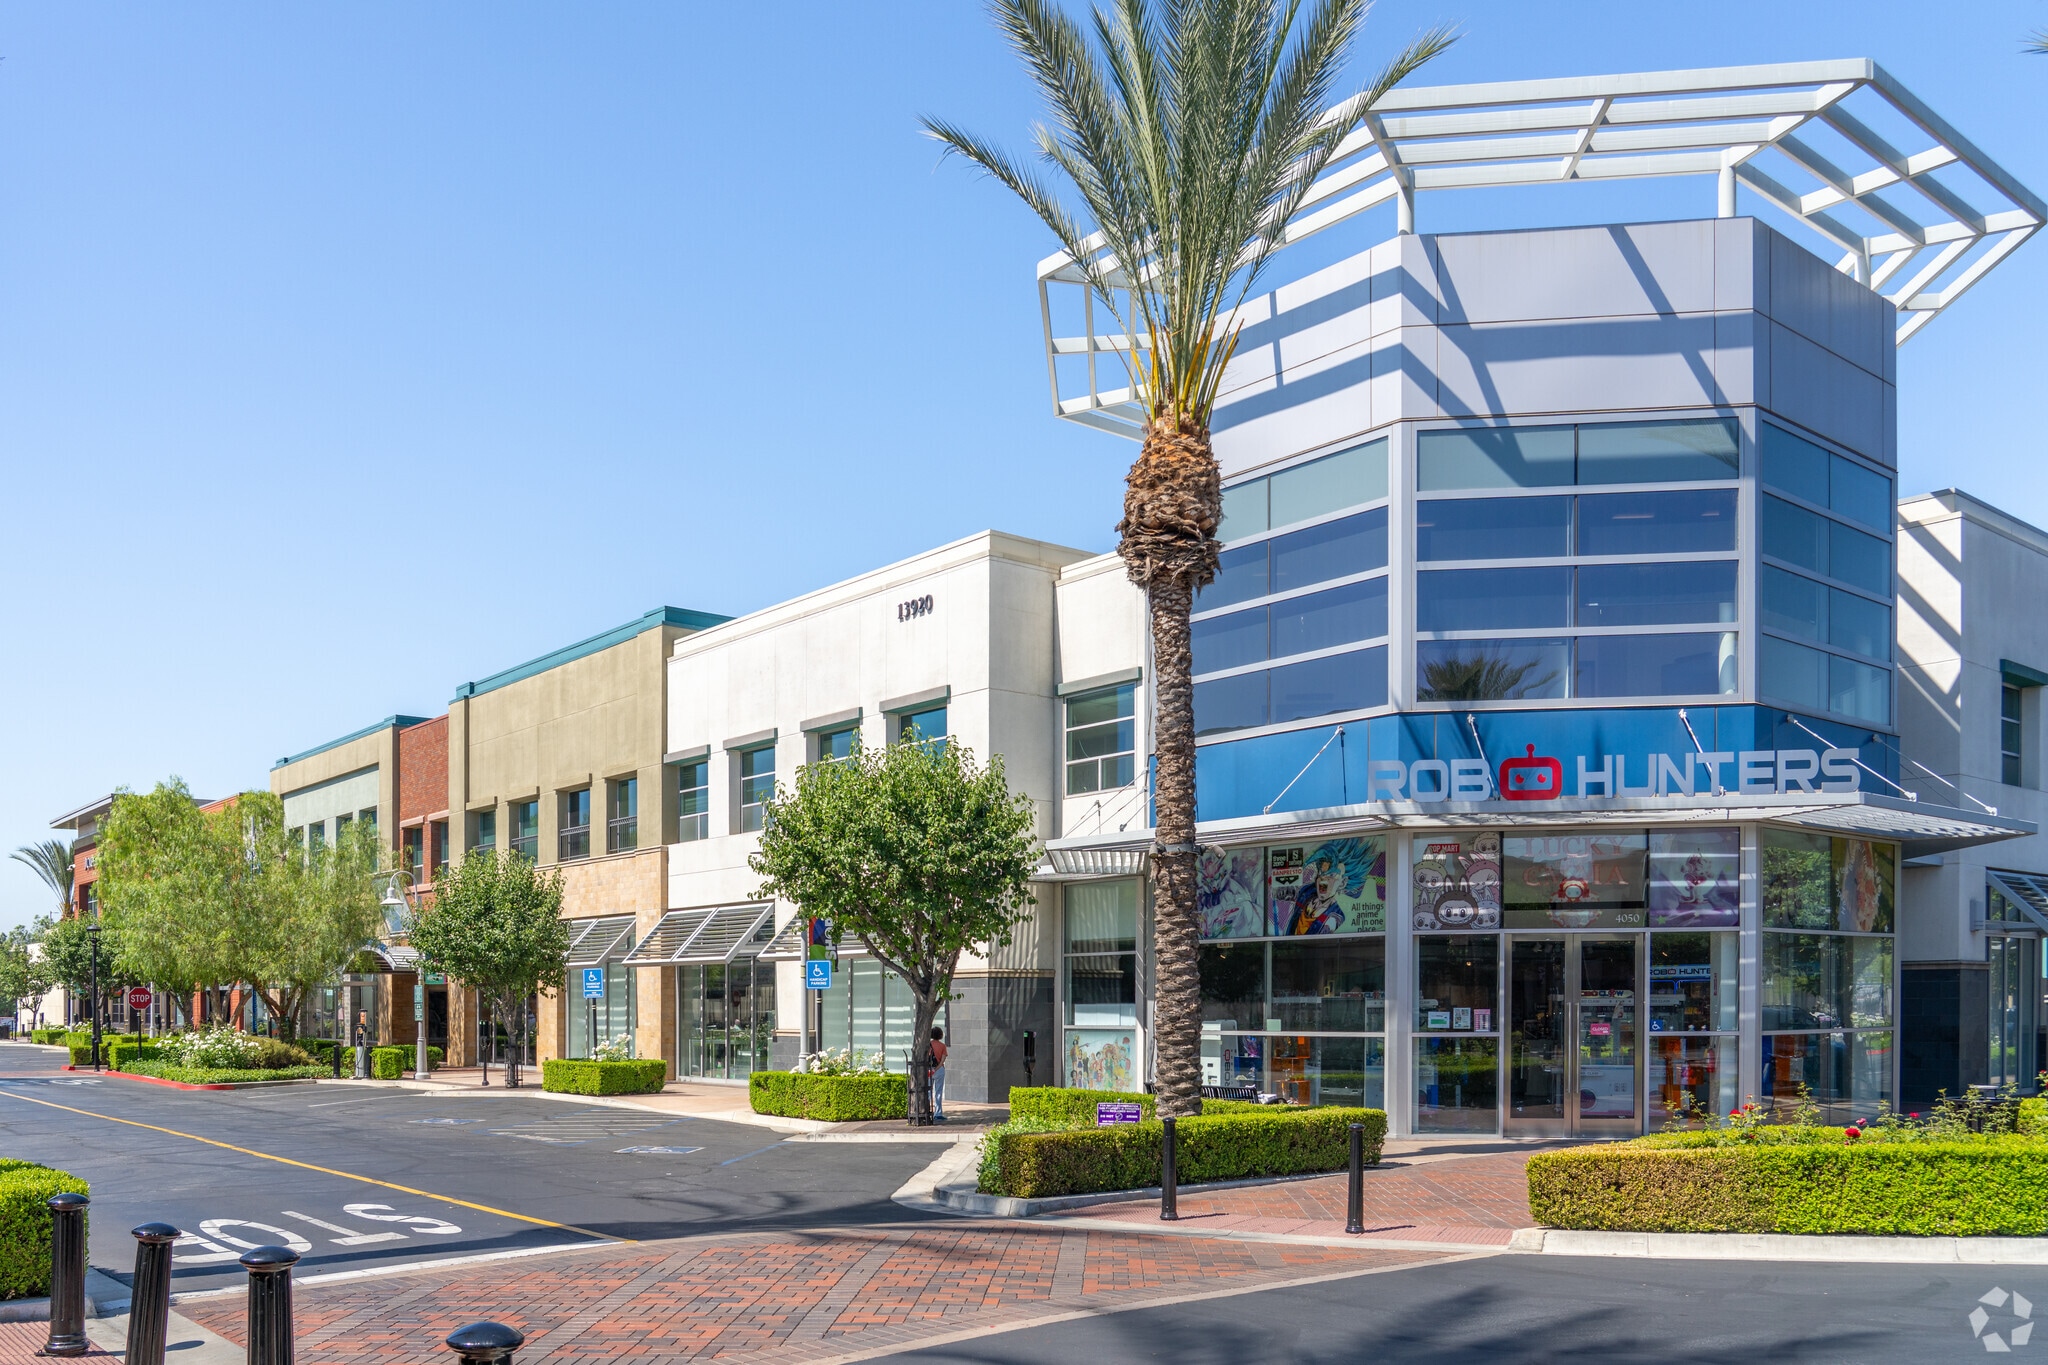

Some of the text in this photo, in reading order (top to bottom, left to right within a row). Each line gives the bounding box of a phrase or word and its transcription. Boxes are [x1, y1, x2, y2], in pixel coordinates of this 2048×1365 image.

[897, 594, 933, 620] 13920
[1577, 748, 1861, 799] HUNTERS
[1442, 844, 1459, 853] MART
[1523, 836, 1628, 858] LUCKY
[1351, 903, 1385, 911] All things
[1615, 914, 1640, 923] 4050
[131, 994, 150, 1003] STOP
